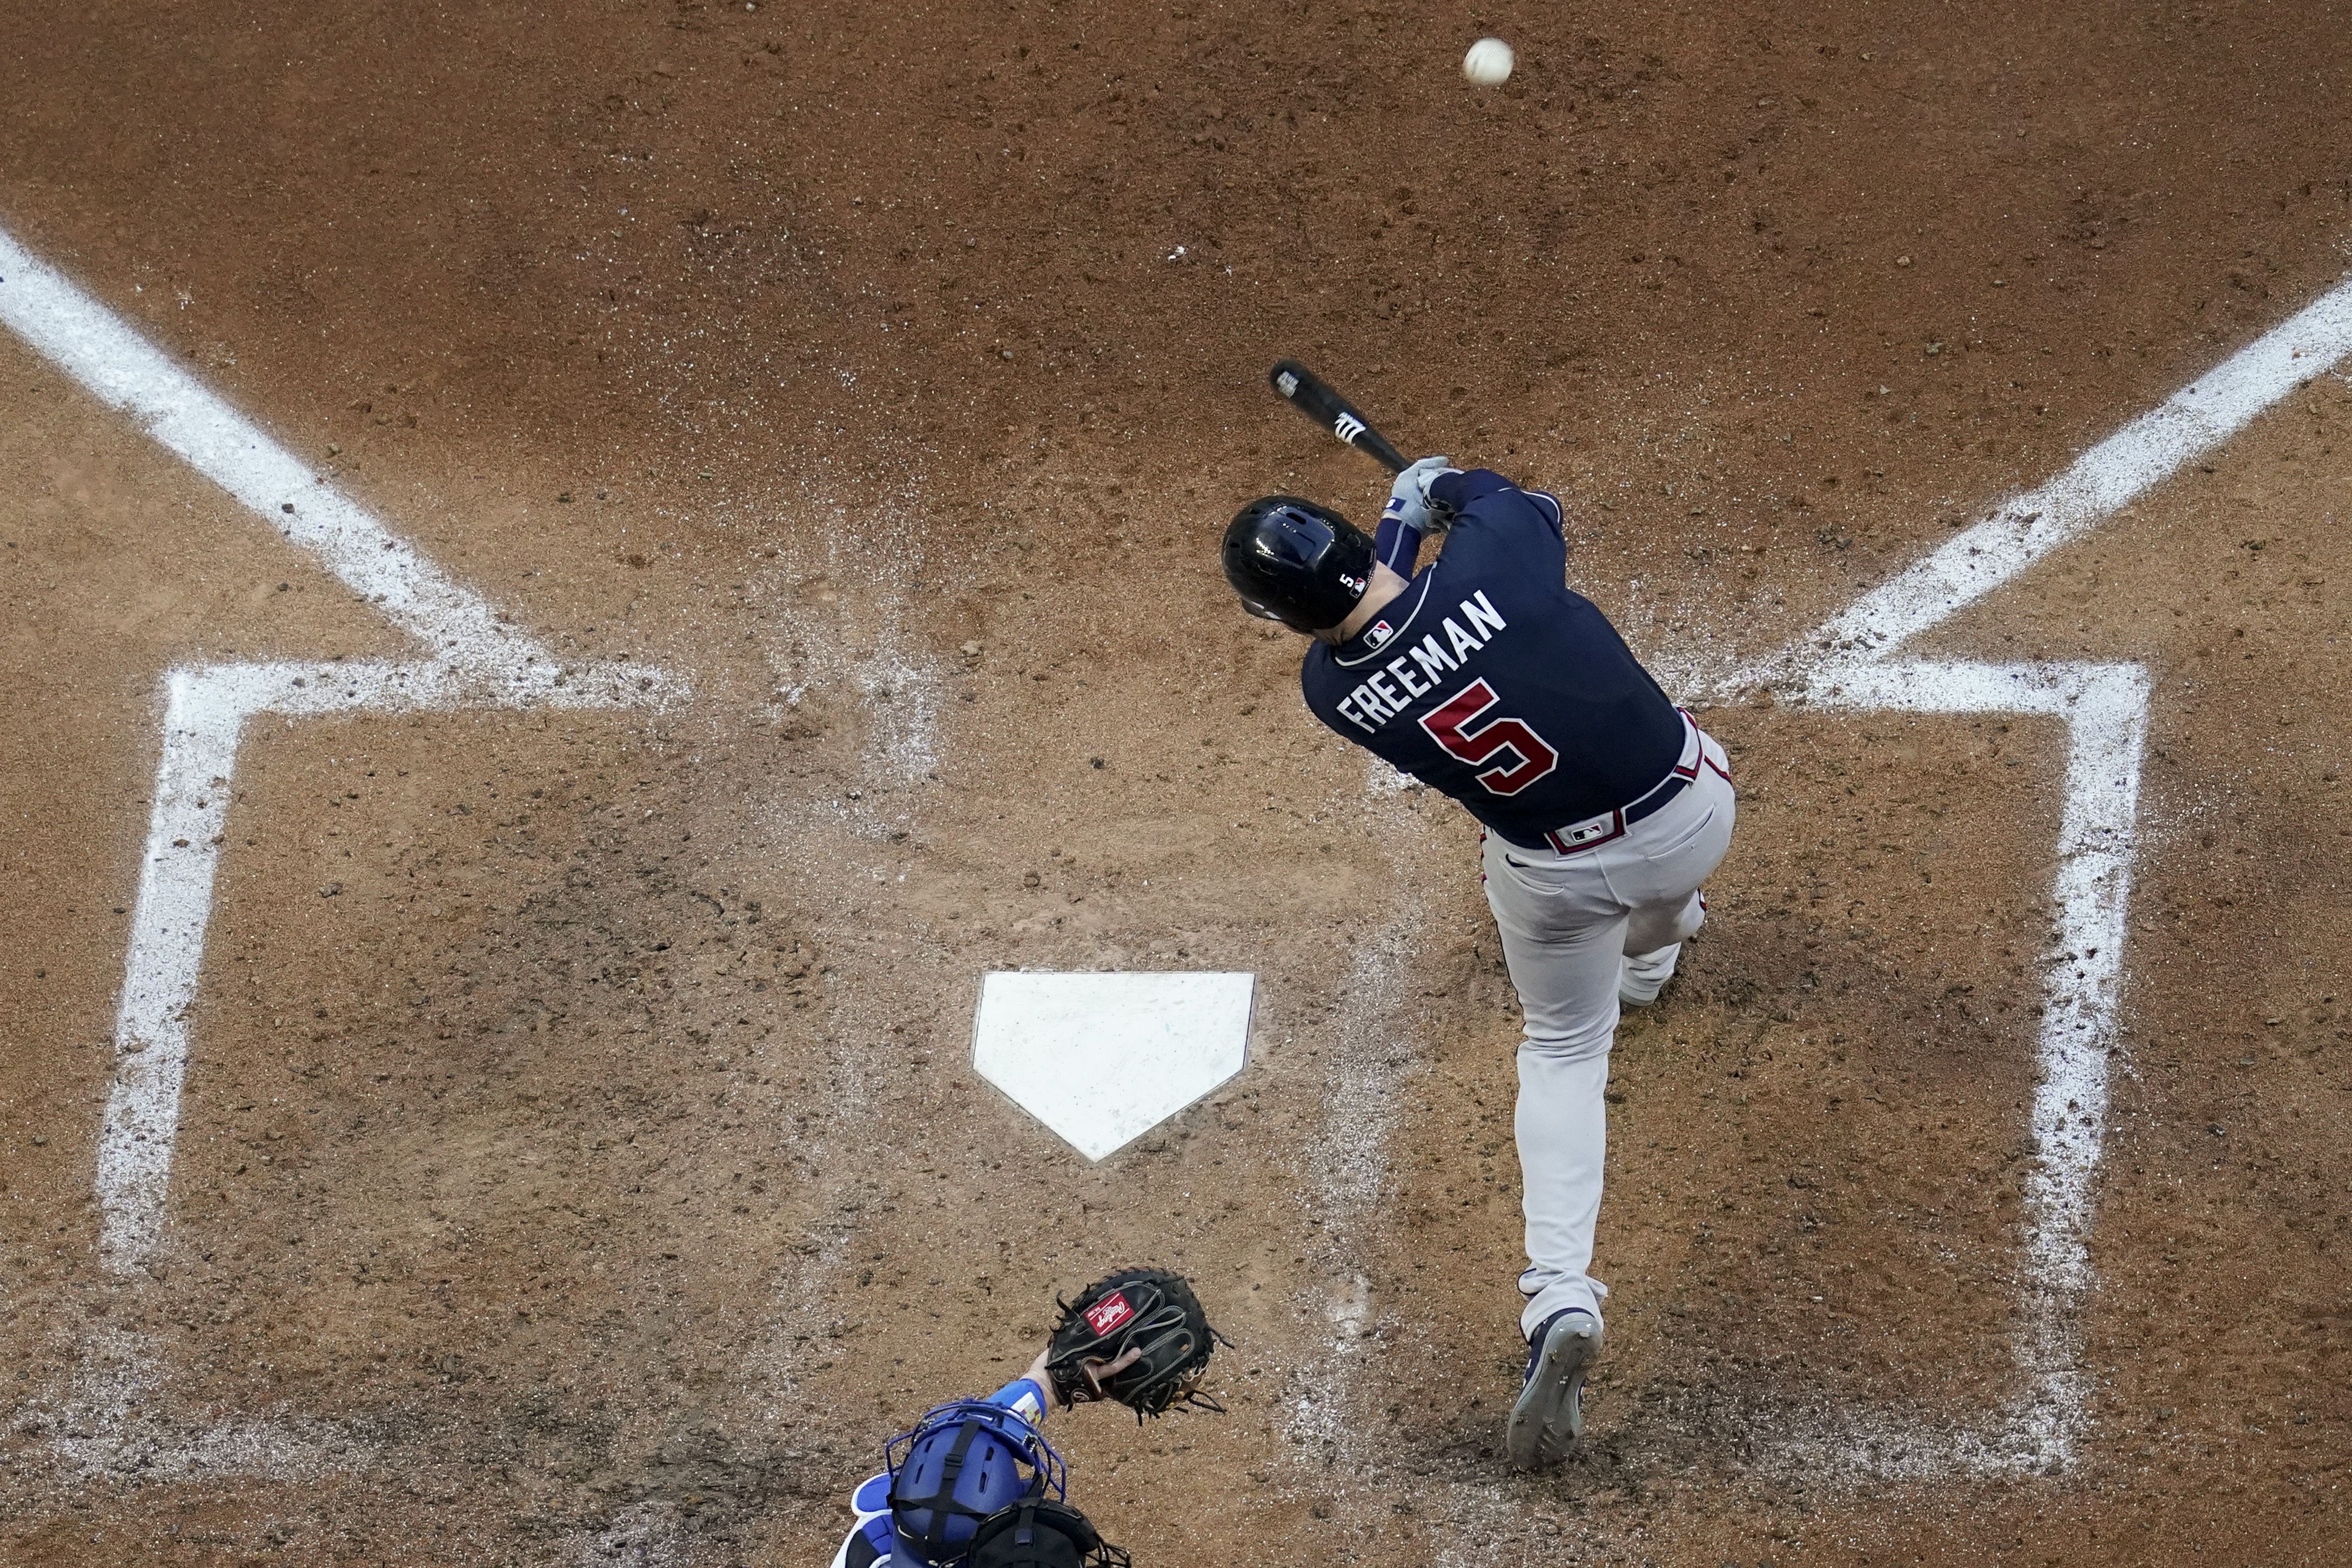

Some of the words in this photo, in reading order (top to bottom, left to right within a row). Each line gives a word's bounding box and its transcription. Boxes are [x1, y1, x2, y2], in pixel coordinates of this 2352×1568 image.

[1339, 574, 1354, 587] 5
[1336, 589, 1507, 734] FREEMAN
[1417, 676, 1559, 796] 5
